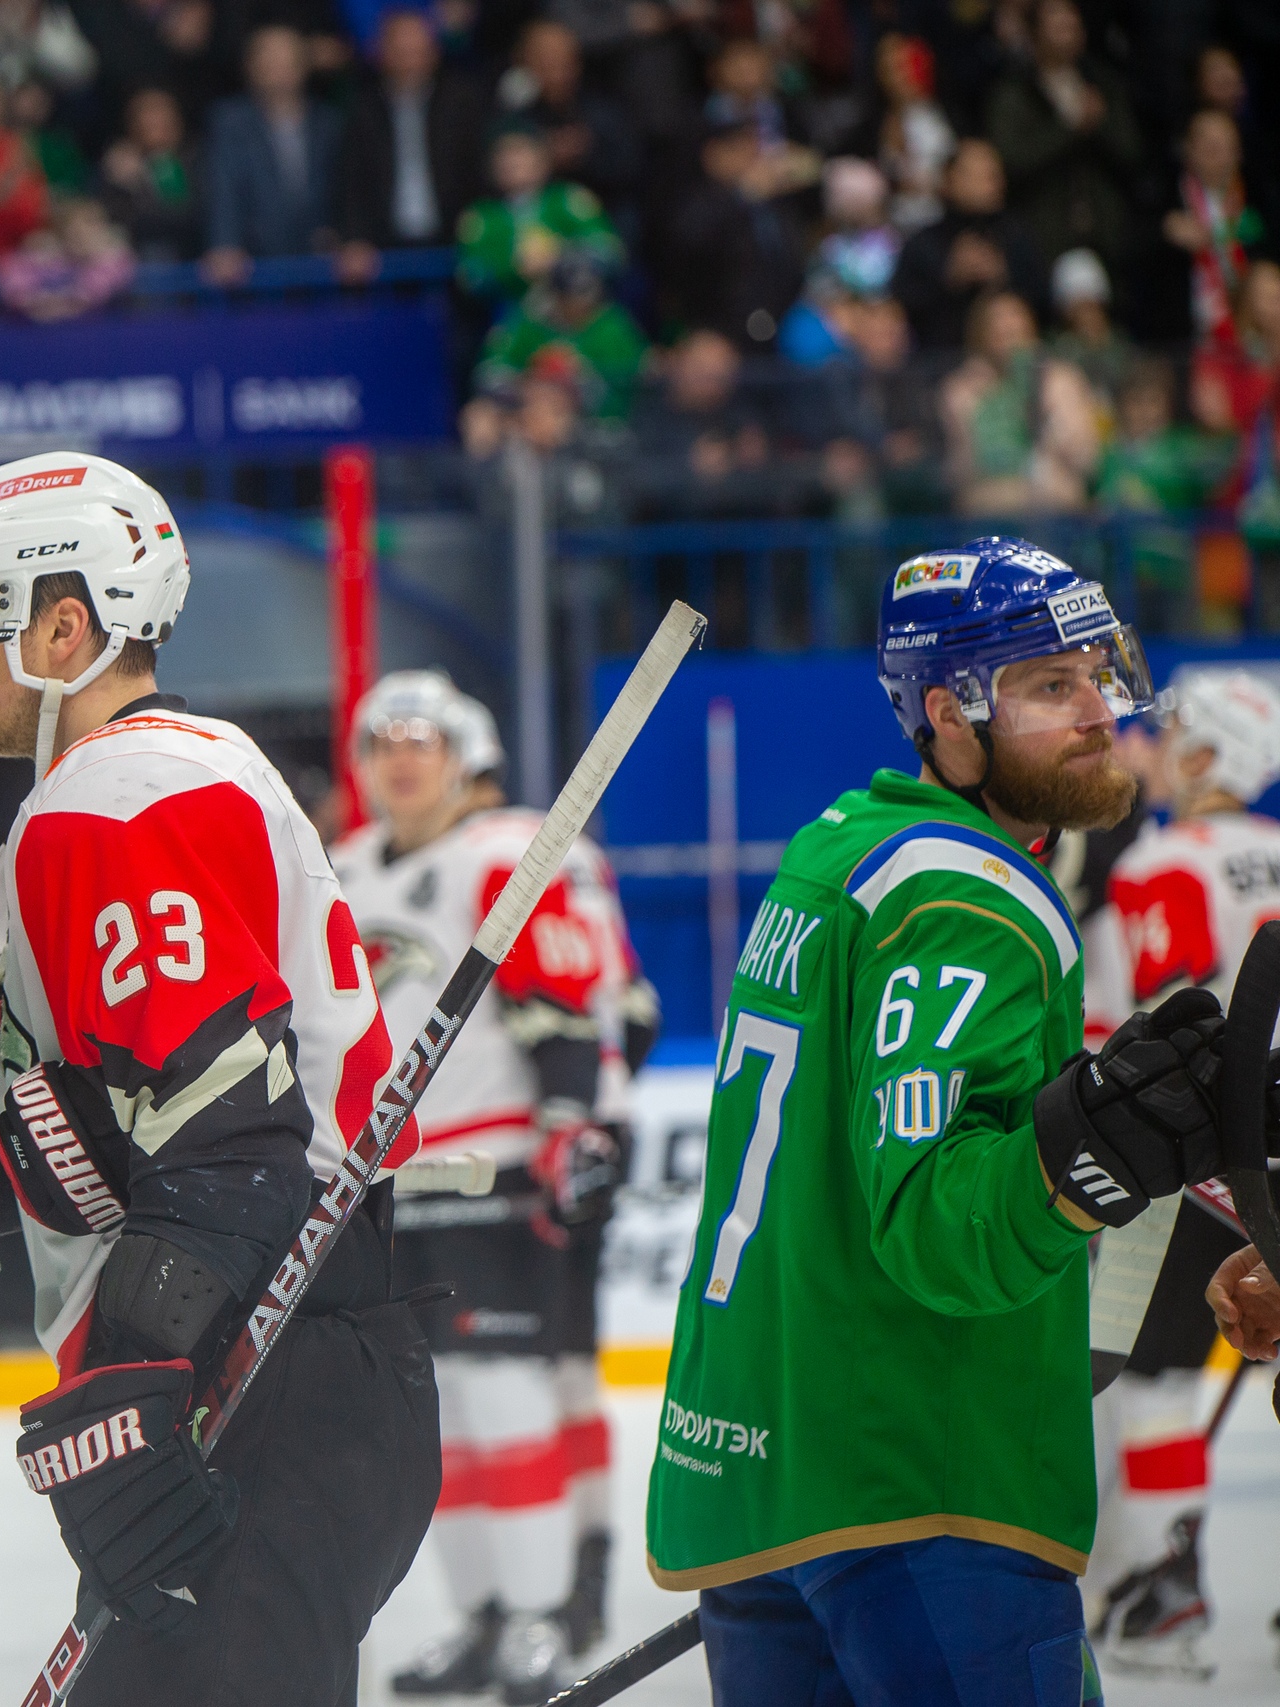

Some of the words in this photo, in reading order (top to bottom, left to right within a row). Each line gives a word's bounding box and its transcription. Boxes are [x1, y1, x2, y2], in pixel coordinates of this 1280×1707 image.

[17, 541, 79, 559] CCM
[1053, 592, 1107, 617] СОГАЗ
[885, 632, 938, 650] BAUER
[94, 889, 206, 1008] 23
[736, 897, 822, 996] MARK
[875, 964, 987, 1059] 67
[10, 1134, 29, 1170] STAS
[17, 1407, 148, 1491] RRIOR
